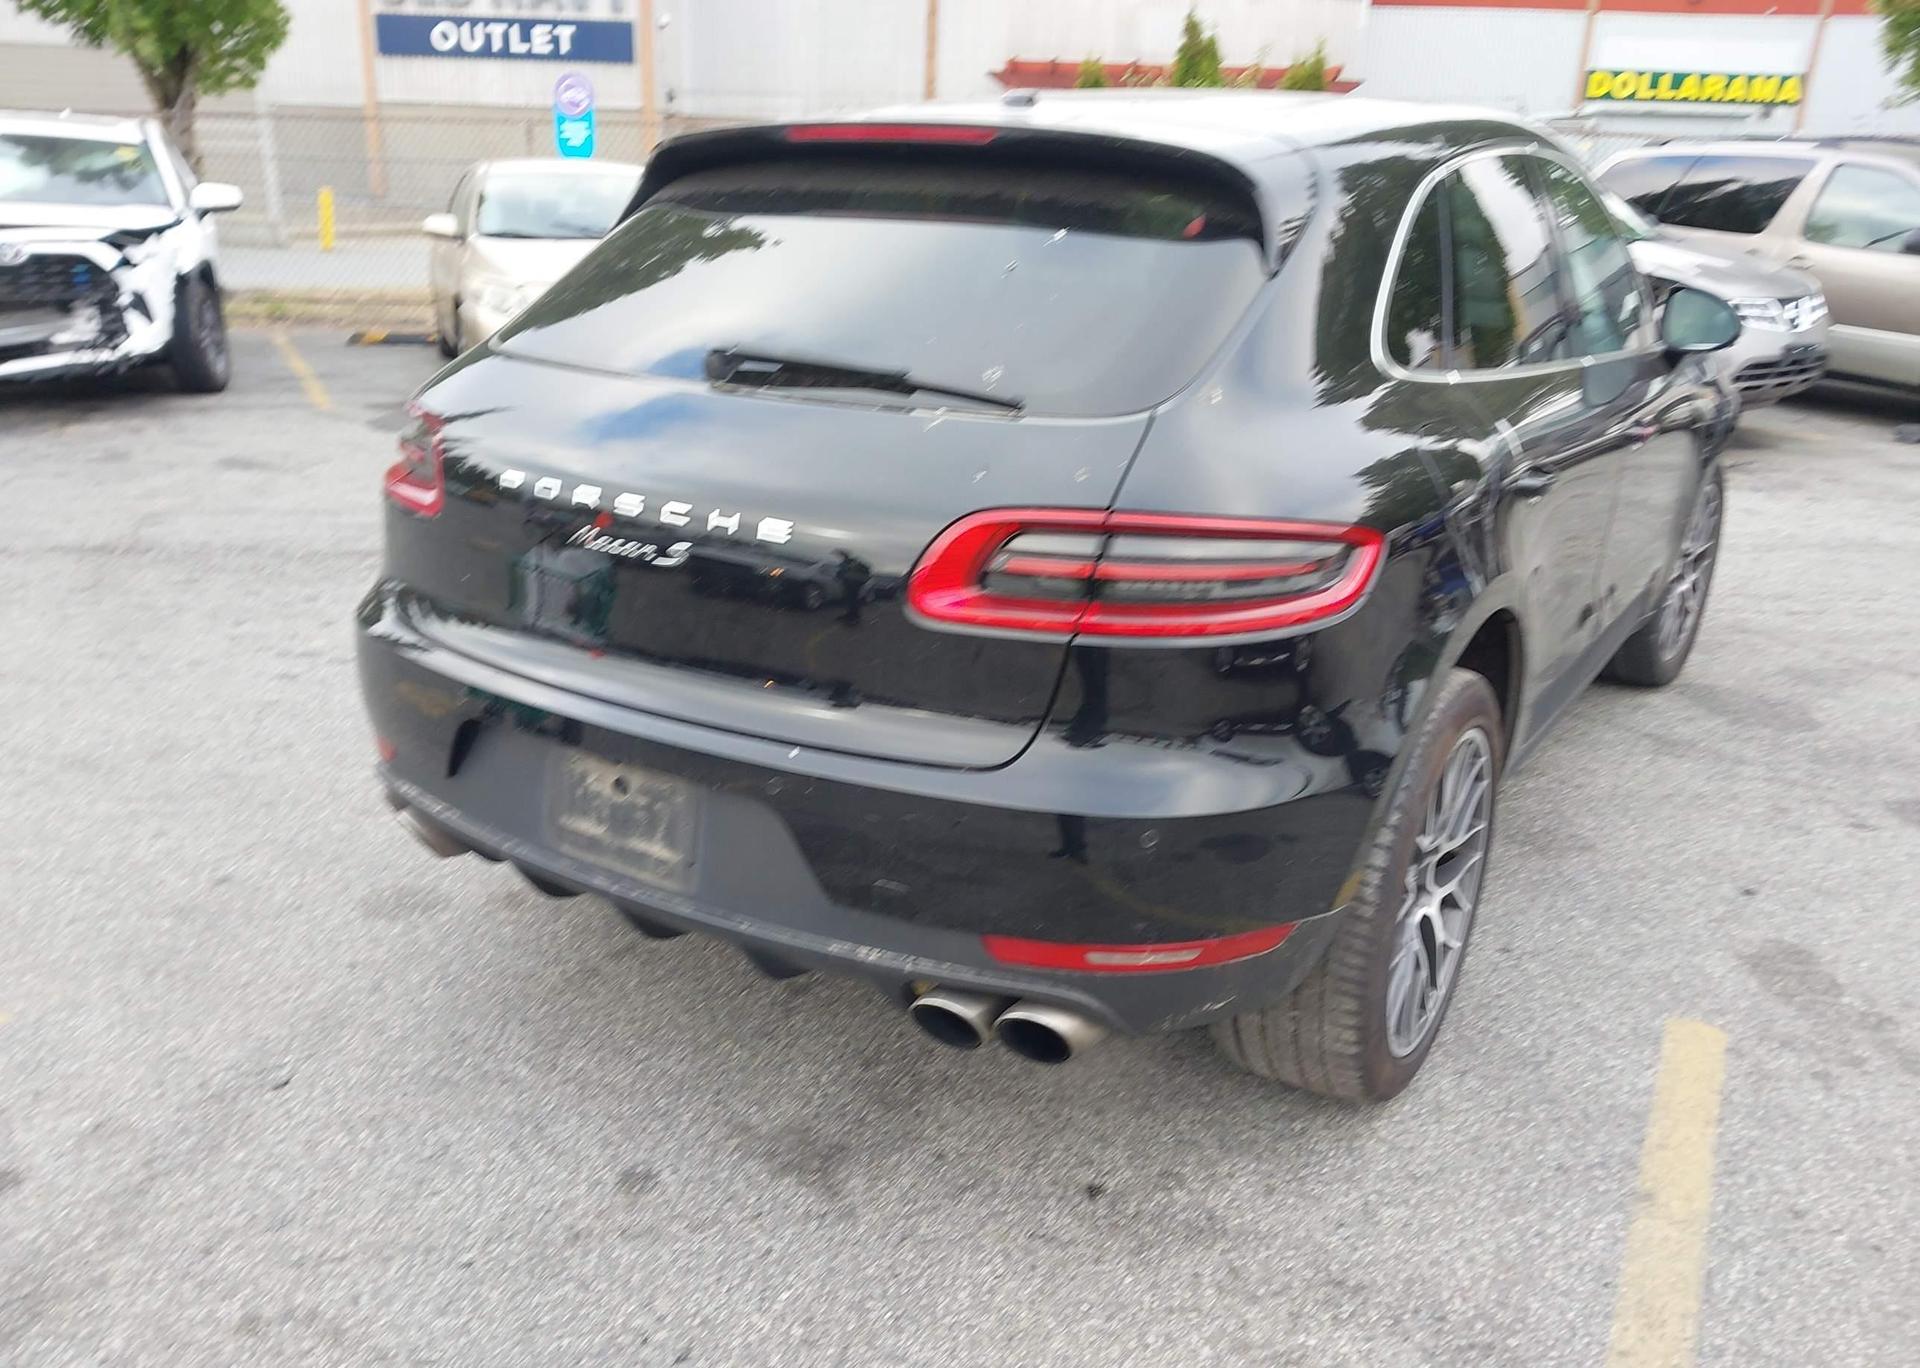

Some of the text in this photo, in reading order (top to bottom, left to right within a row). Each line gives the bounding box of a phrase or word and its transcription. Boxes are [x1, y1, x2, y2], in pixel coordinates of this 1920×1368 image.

[429, 20, 577, 55] OUTLET
[1585, 70, 1802, 104] DOLLARAMA
[499, 468, 795, 545] PORSCHE
[650, 541, 694, 567] S
